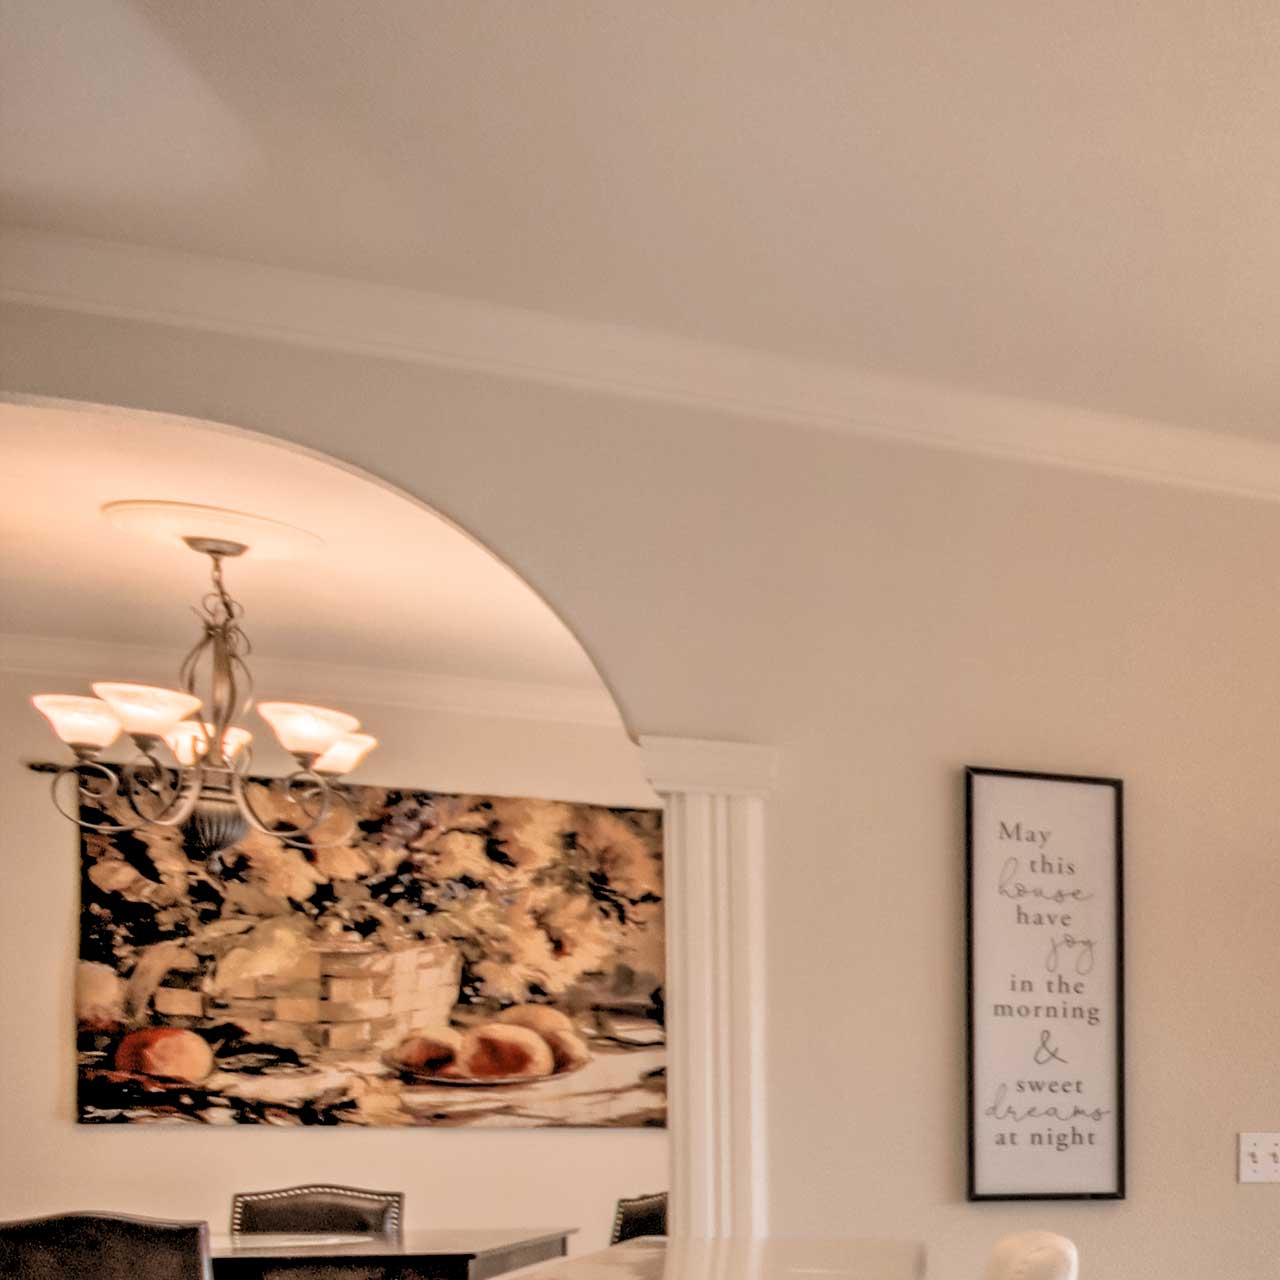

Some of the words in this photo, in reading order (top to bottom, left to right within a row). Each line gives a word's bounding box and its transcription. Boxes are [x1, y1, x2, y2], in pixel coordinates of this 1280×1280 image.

[998, 820, 1052, 848] May
[1029, 854, 1076, 876] this
[997, 857, 1095, 903] house
[1016, 905, 1073, 927] have
[1045, 934, 1097, 975] joy
[1010, 974, 1035, 994] in
[1046, 973, 1086, 995] the
[993, 1002, 1101, 1026] morning
[1033, 1029, 1068, 1064] &
[1016, 1078, 1084, 1094] sweet
[985, 1083, 1112, 1122] dreams
[995, 1127, 1018, 1146] at
[1030, 1125, 1097, 1151] night
